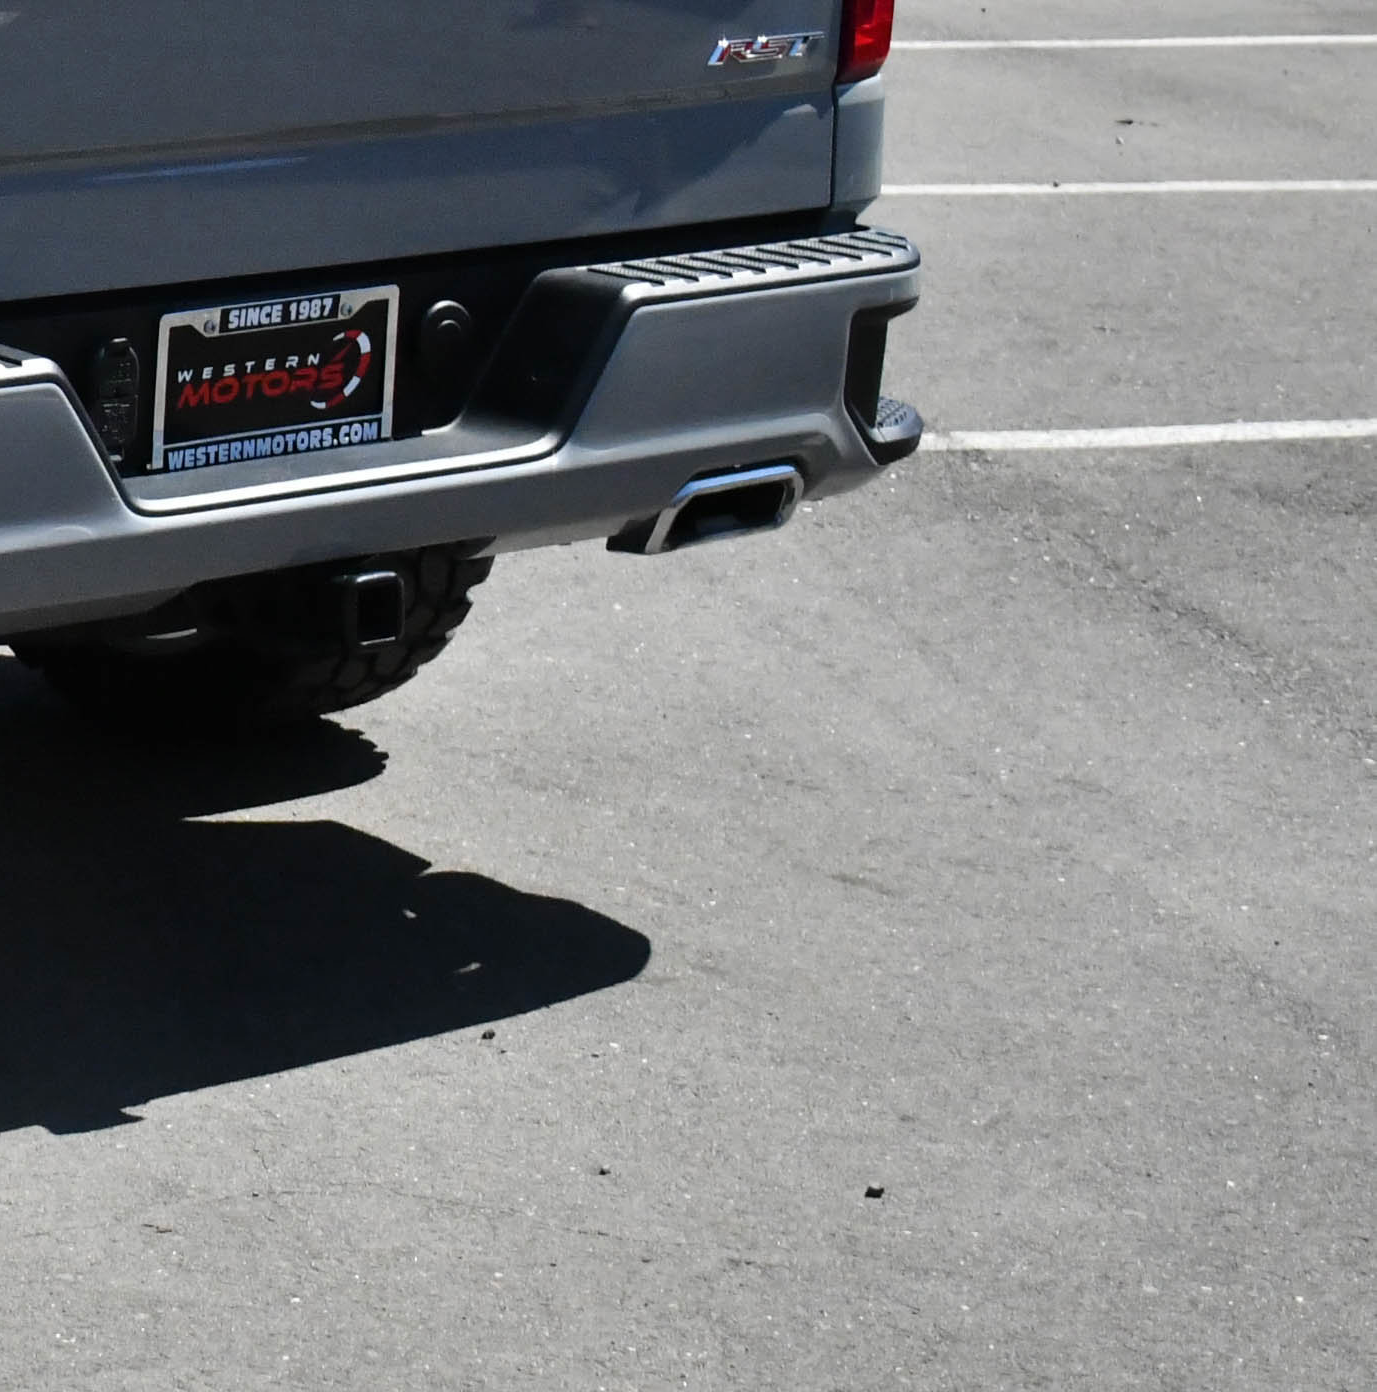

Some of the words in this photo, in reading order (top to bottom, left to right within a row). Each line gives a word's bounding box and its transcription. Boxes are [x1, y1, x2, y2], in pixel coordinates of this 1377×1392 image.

[707, 31, 824, 66] RST
[227, 302, 282, 330] SINCE
[288, 298, 333, 322] 1987
[177, 352, 321, 383] WESTERN
[177, 361, 345, 409] MOTORS
[168, 421, 379, 471] WESTERNMOTORS.COM
